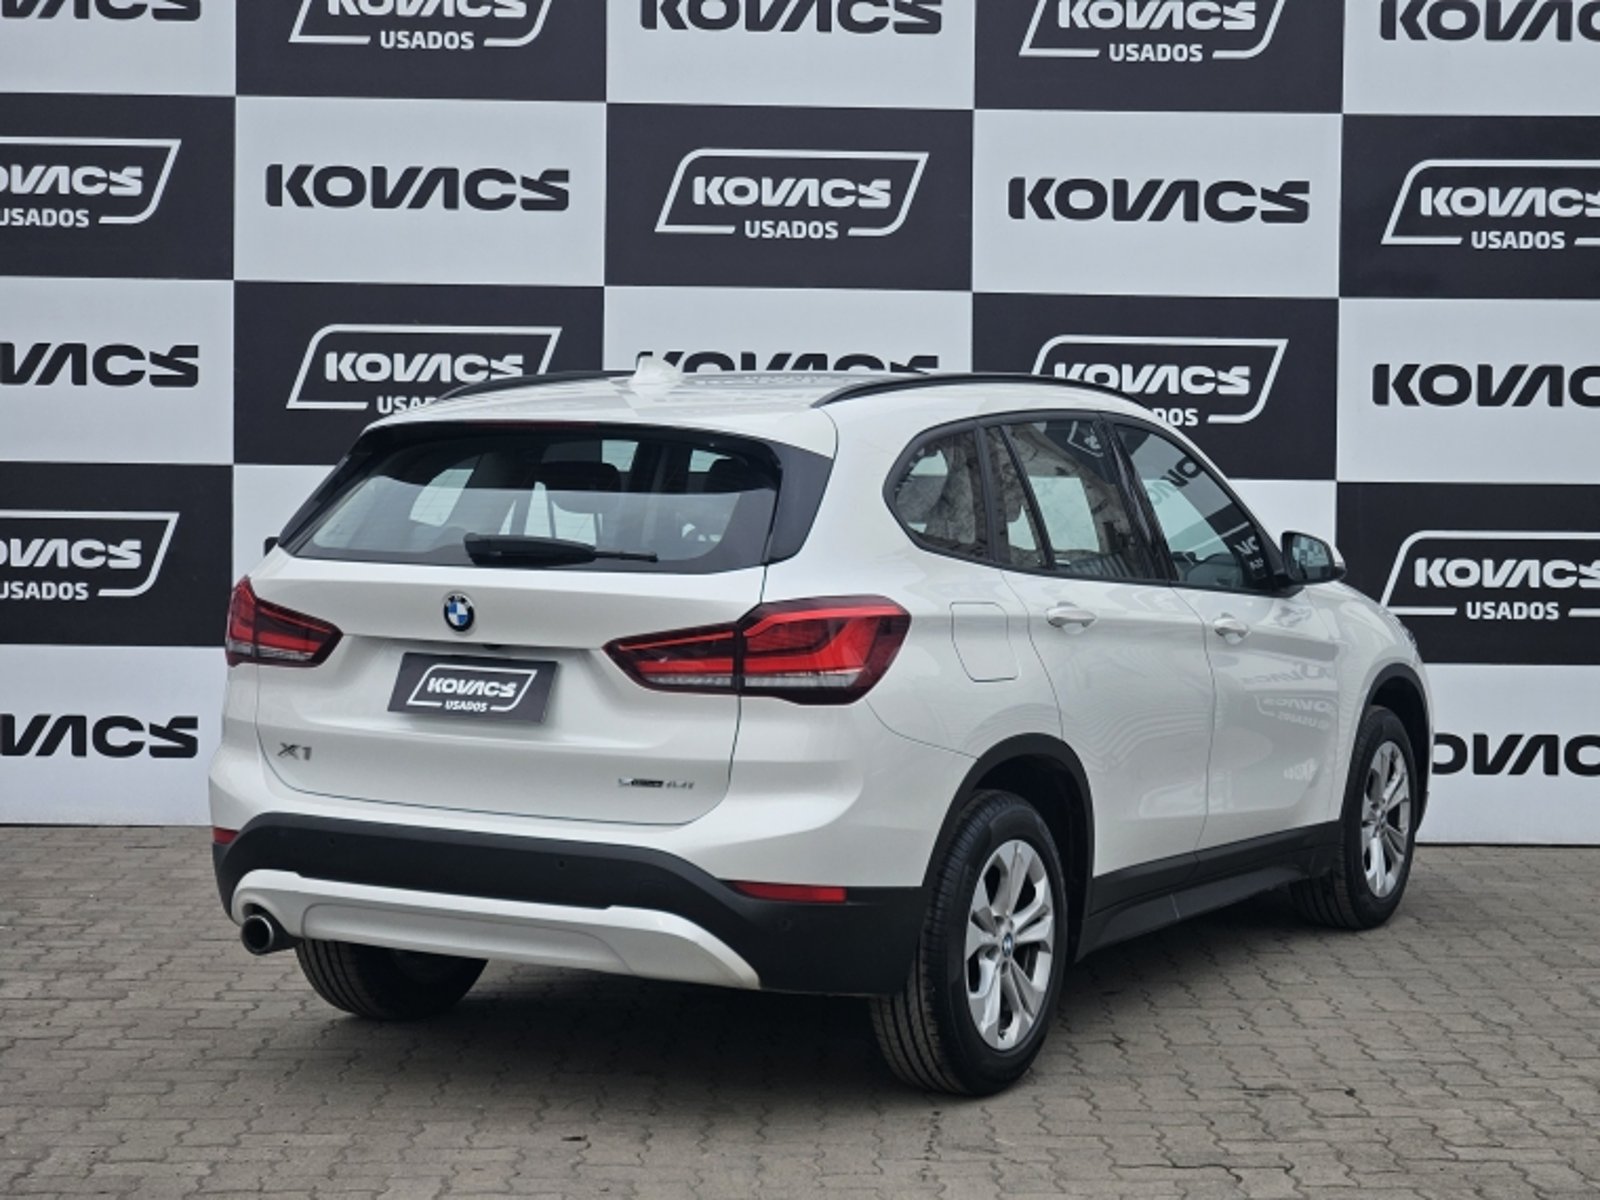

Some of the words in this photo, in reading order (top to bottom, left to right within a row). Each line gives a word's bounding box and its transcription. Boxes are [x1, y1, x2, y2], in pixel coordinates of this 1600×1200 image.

[640, 0, 942, 34] KOVACS
[1058, 0, 1256, 30] KOVACS
[380, 31, 475, 49] USADOS
[1109, 43, 1203, 62] USADOS
[0, 164, 143, 196] VACS
[265, 163, 570, 211] KOVACS
[693, 176, 891, 209] KOVACS
[1007, 177, 1310, 224] KOVACS
[744, 220, 839, 239] USADOS
[1471, 231, 1566, 249] USADOS
[325, 352, 523, 383] KOVACS
[0, 538, 142, 569] VACS
[1466, 602, 1560, 620] USADOS
[427, 677, 517, 698] KOVACS
[444, 700, 489, 712] USADOS
[277, 742, 312, 761] X1
[1431, 733, 1600, 777] OVAC
